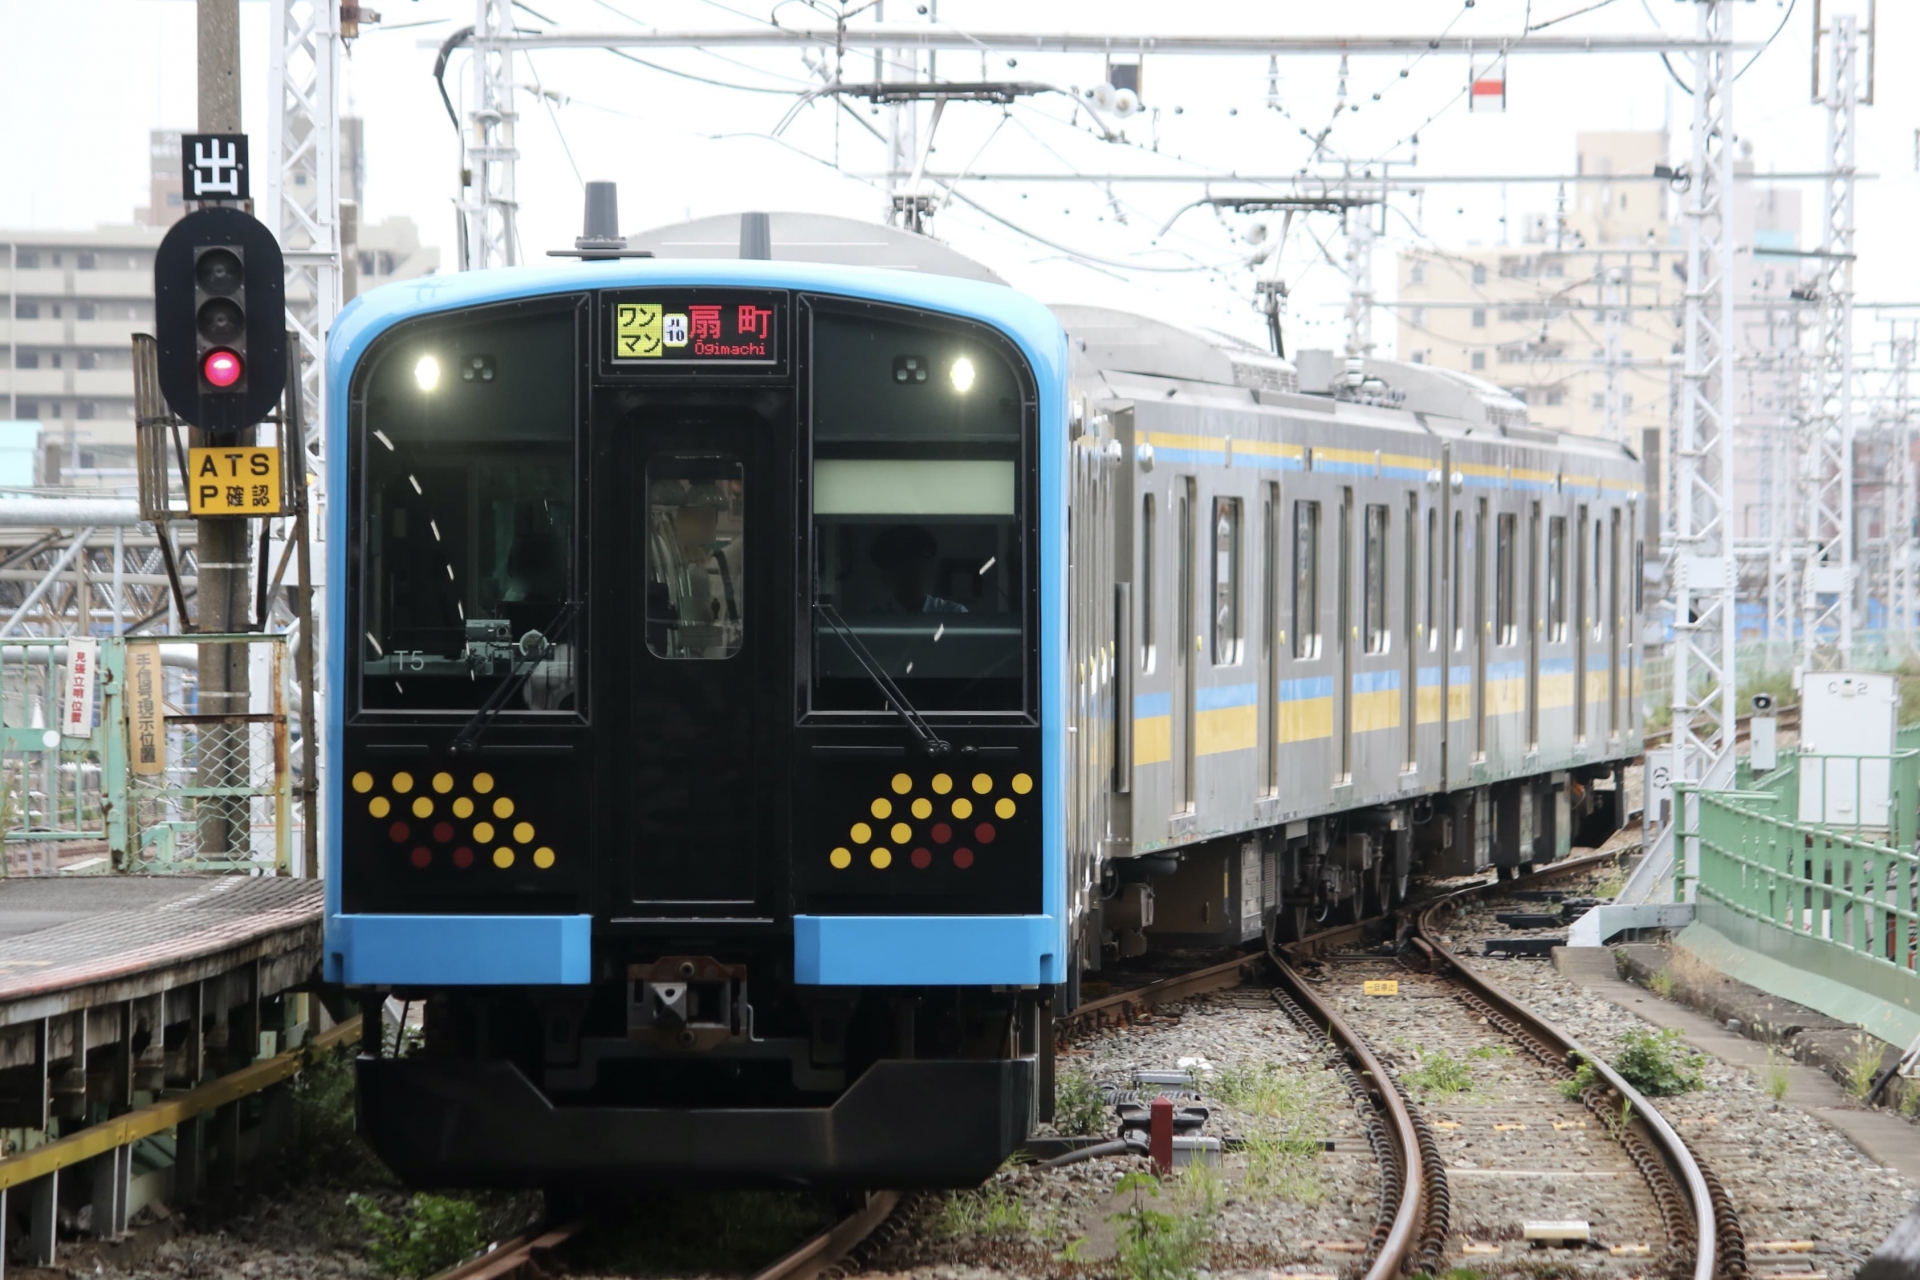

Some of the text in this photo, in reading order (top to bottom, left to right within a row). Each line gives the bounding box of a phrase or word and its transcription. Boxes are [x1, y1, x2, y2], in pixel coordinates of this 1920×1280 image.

[194, 138, 239, 196] 出
[619, 307, 656, 327] ワン
[688, 305, 772, 339] 扇町
[620, 333, 660, 353] マン
[666, 330, 685, 342] 10
[199, 453, 270, 477] ATS
[393, 650, 424, 671] T5
[72, 652, 86, 723] 見張立哨位置
[135, 654, 156, 763] 手信号現示位置
